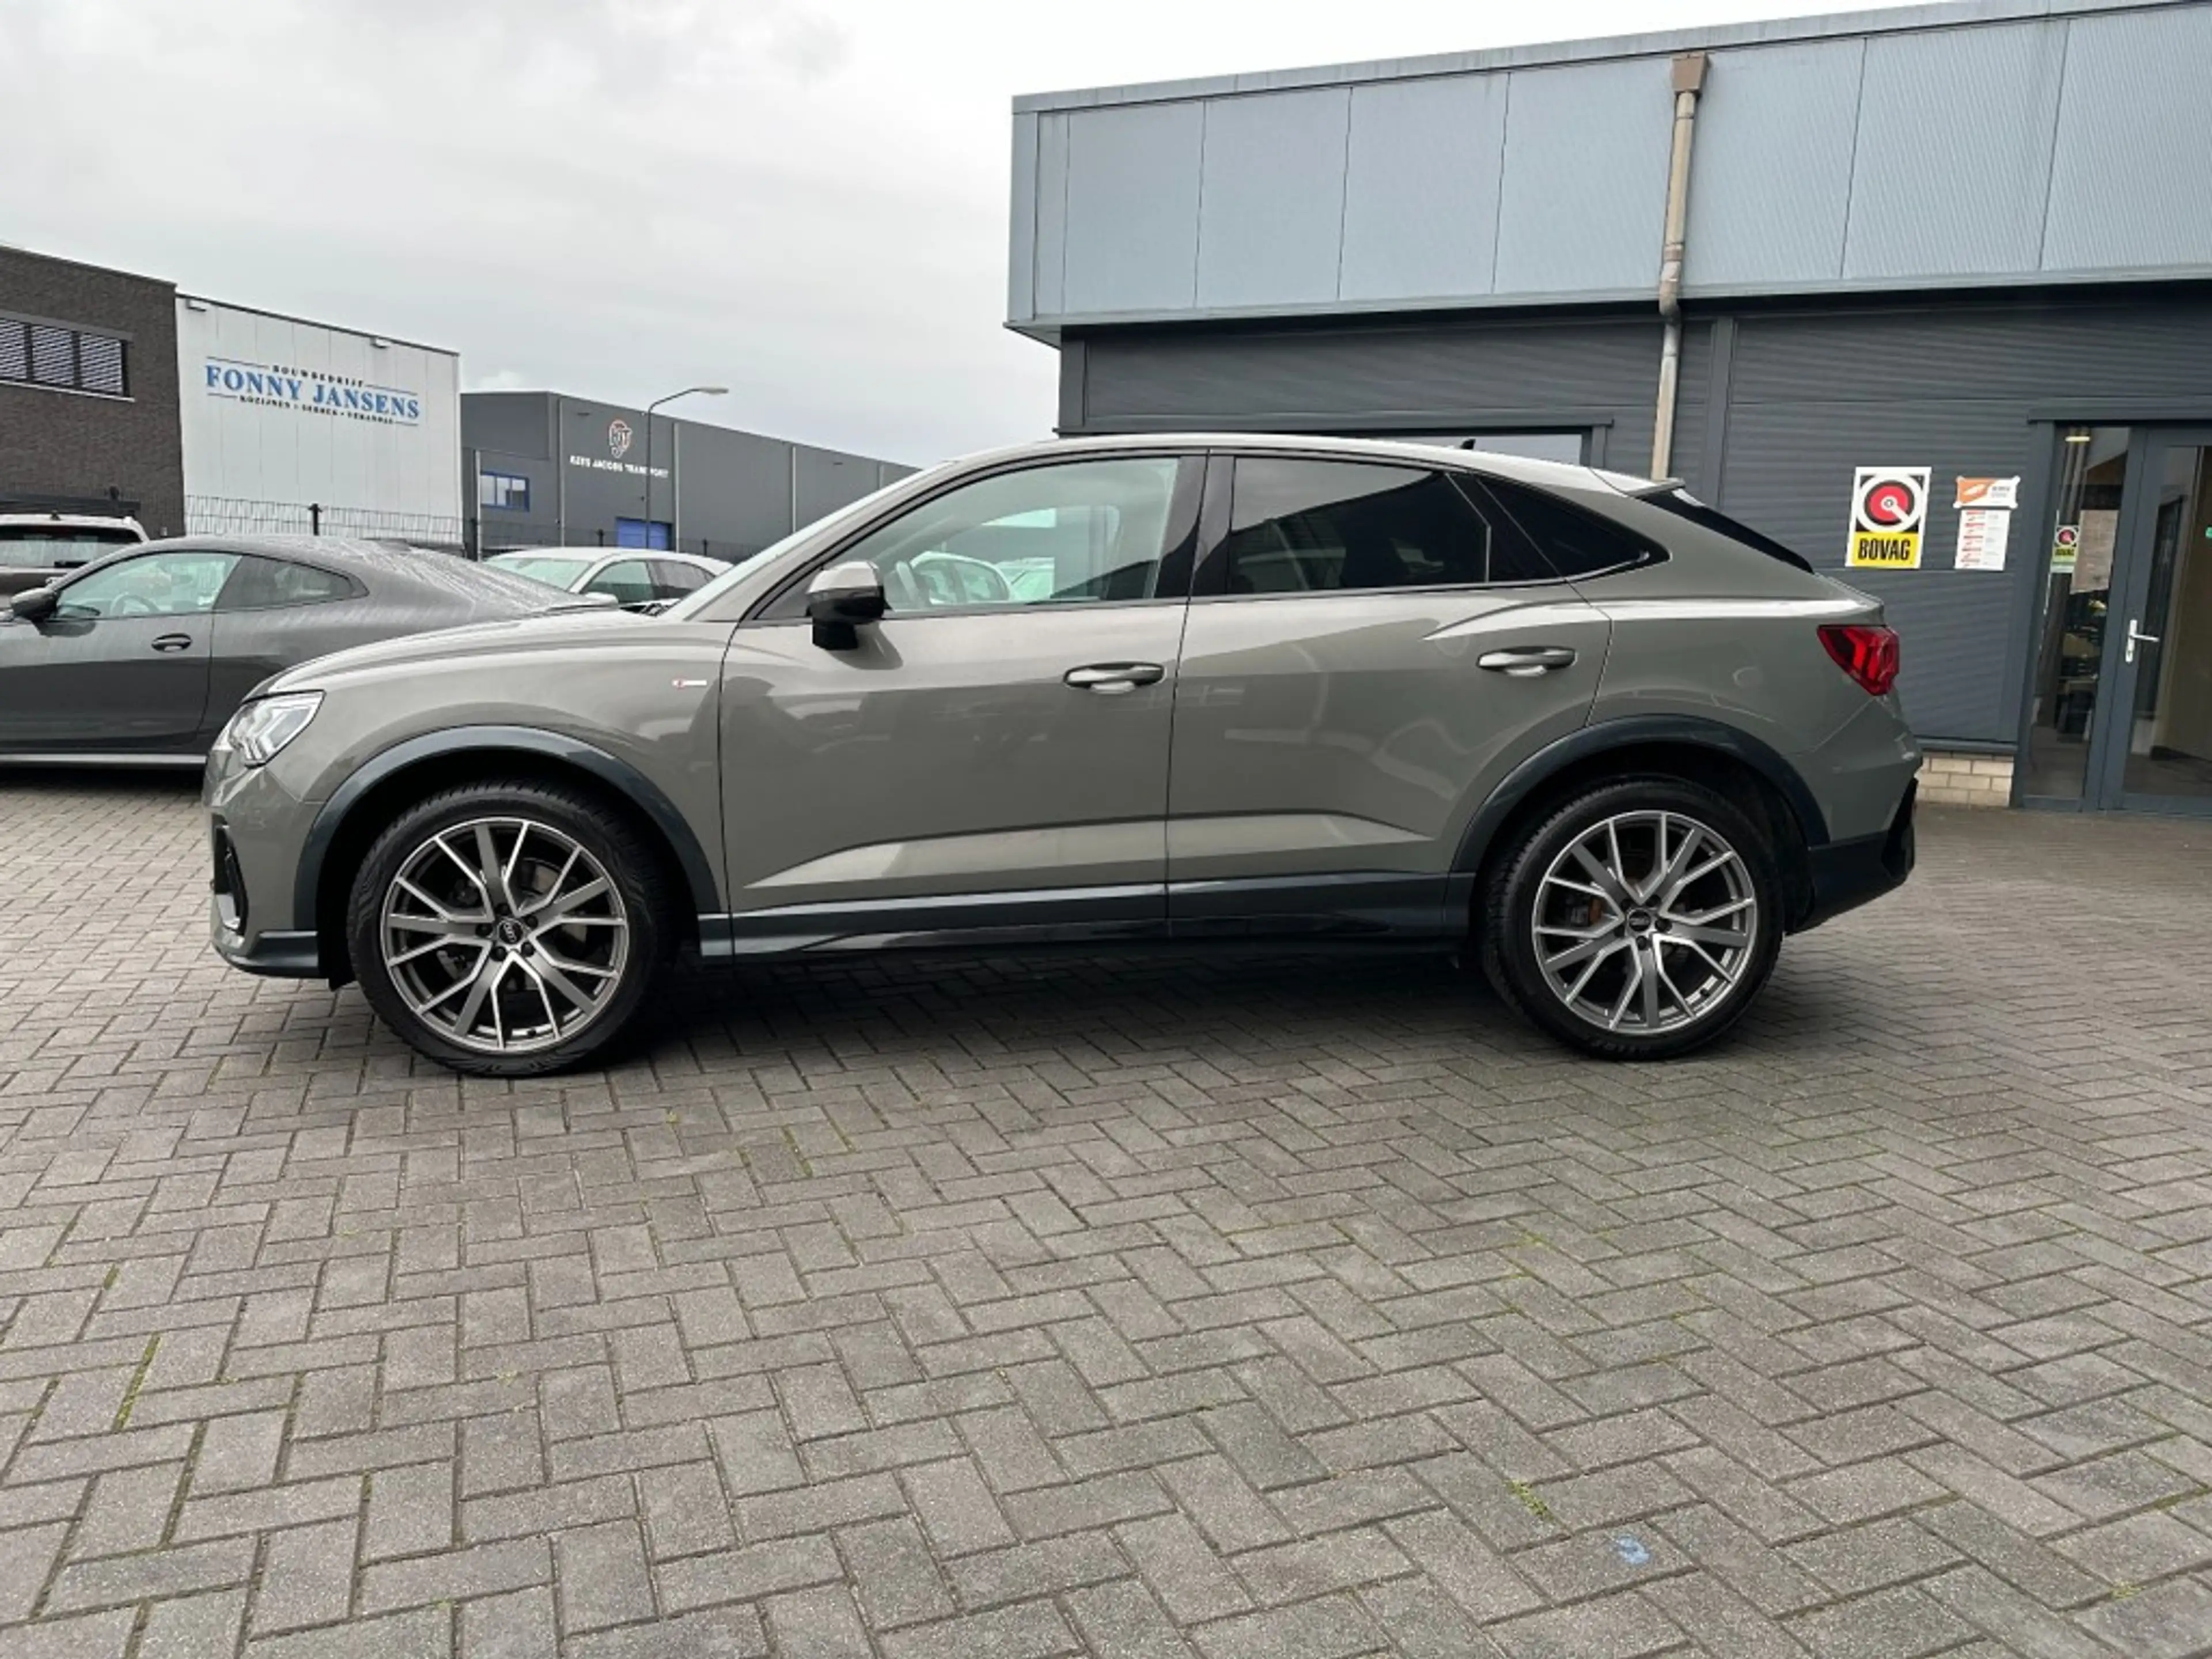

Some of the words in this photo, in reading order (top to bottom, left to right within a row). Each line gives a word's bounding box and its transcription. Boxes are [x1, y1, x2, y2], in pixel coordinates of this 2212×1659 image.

[206, 364, 303, 401] FONNY
[312, 384, 420, 420] JANSENS
[1857, 537, 1911, 561] BOVAG
